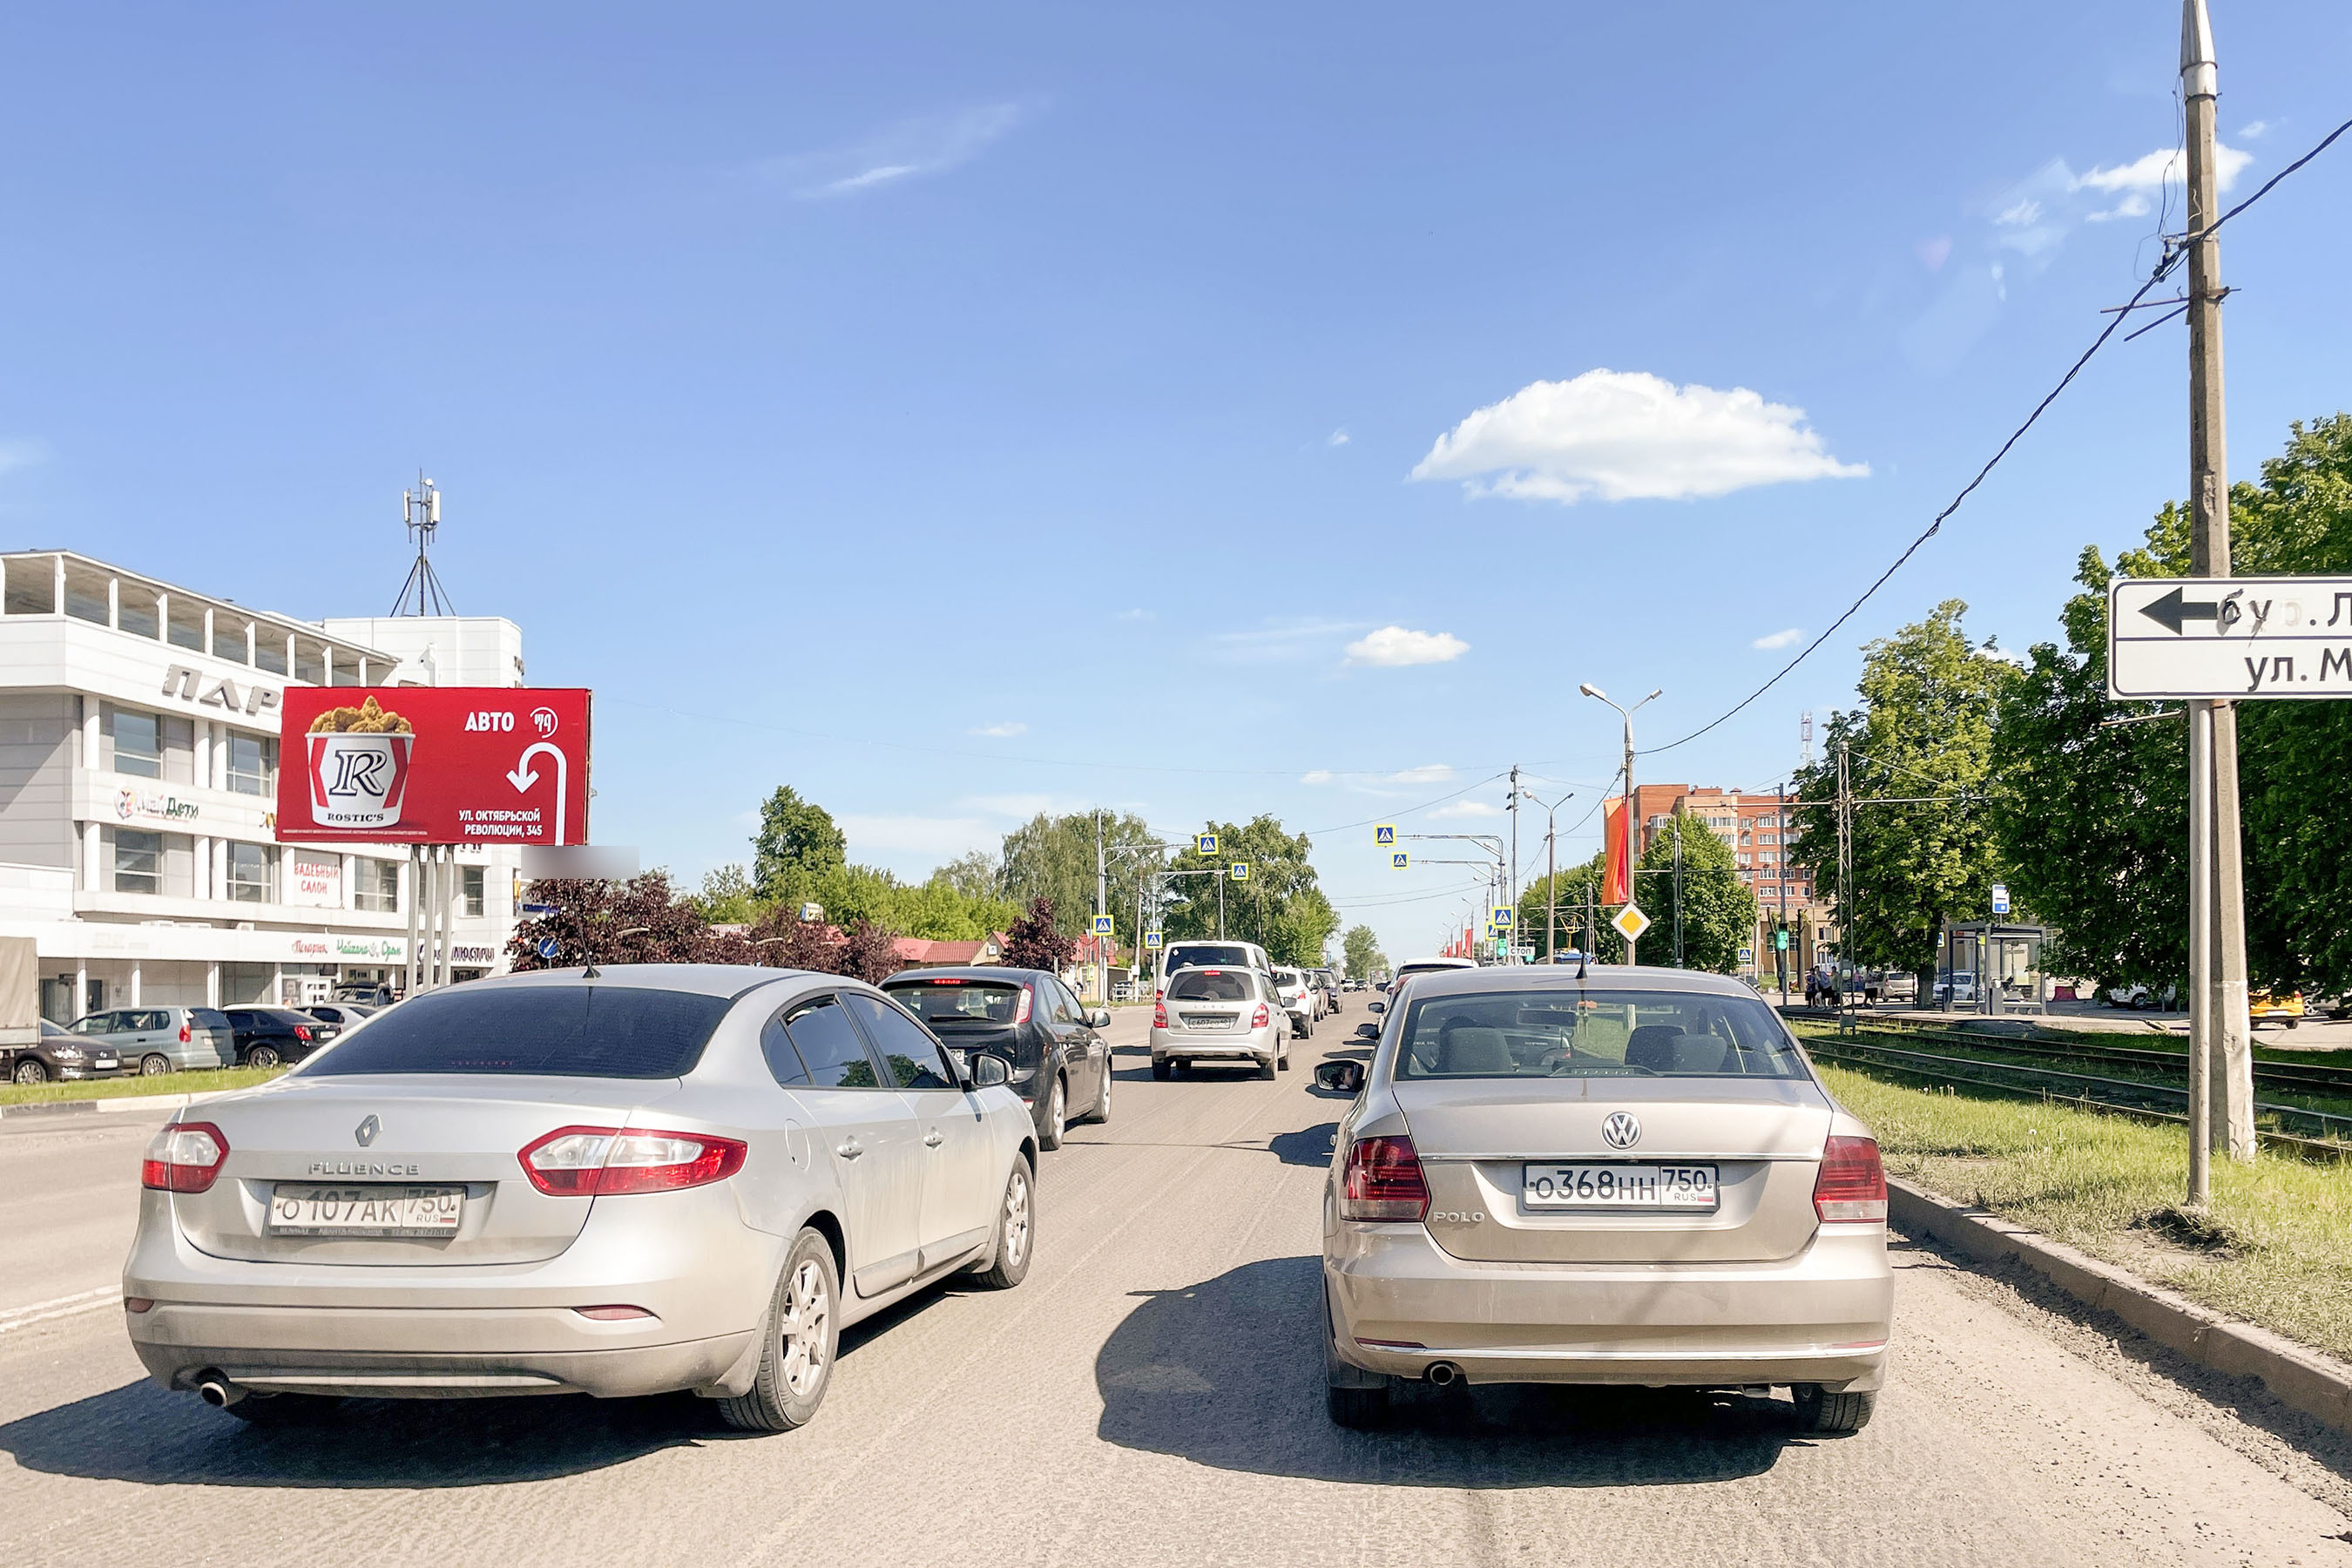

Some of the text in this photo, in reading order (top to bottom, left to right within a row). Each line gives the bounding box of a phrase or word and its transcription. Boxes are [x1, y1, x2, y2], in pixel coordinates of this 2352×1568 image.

[2243, 656, 2308, 693] ул.
[464, 711, 515, 733] АВТО
[328, 812, 384, 822] ROSTIC'S
[458, 808, 541, 822] УЛ. ОКТЯБРЬСКОЙ
[464, 823, 543, 838] РЕВОЛЮЦИИ, 345
[301, 879, 328, 895] САЛОН
[308, 1161, 420, 1176] FLUENCE
[1662, 1168, 1708, 1193] 750
[408, 1188, 452, 1213] 750
[1673, 1193, 1697, 1202] RUS
[416, 1213, 439, 1224] RUS
[1432, 1211, 1485, 1224] POLO
